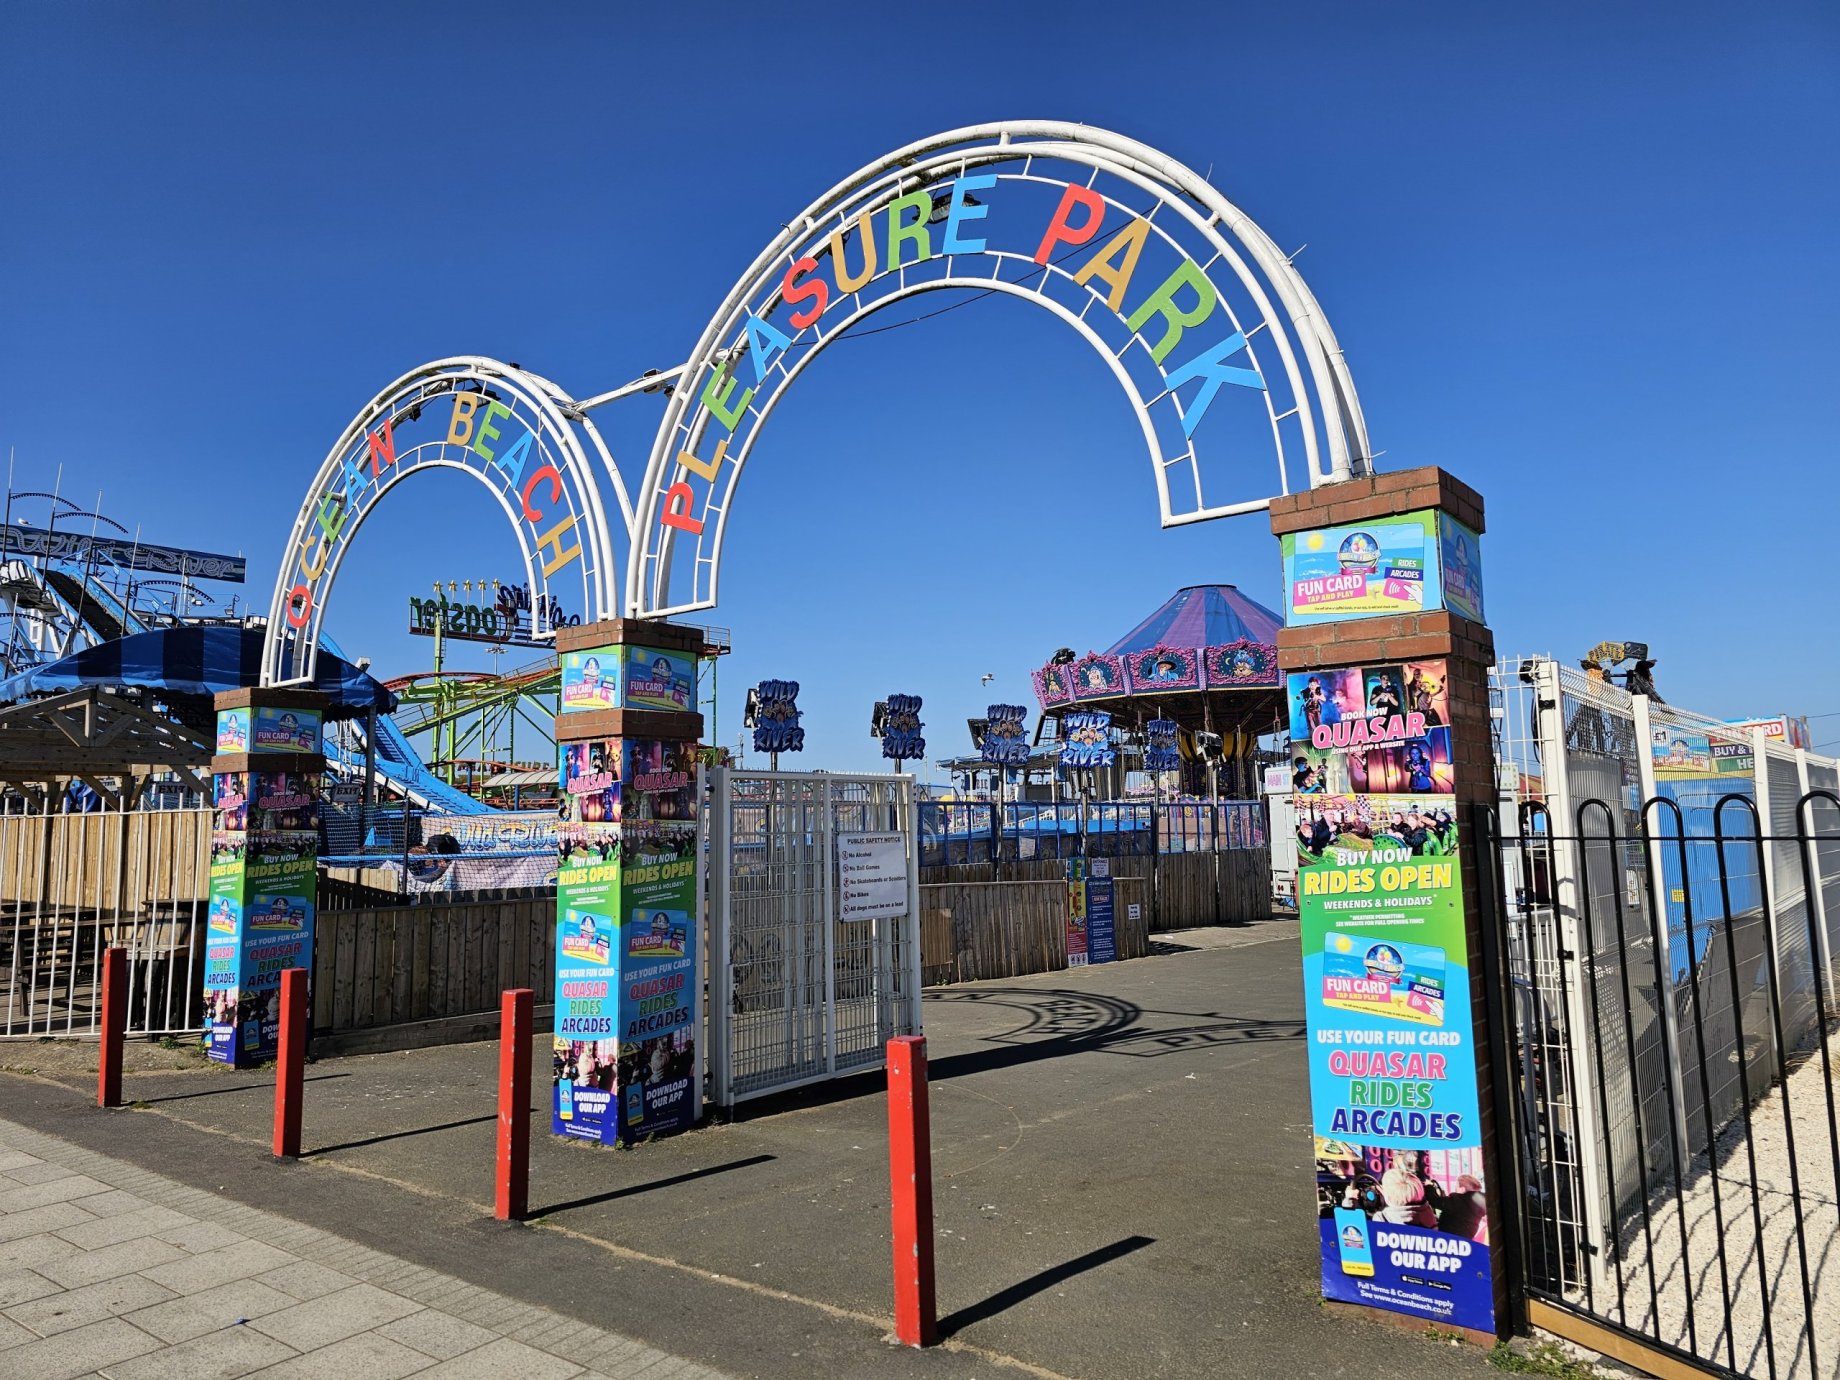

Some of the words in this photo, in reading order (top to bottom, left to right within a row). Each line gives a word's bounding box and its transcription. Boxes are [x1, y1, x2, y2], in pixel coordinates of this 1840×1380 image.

[660, 173, 998, 535] PLEASURE
[1034, 182, 1266, 439] PARK
[286, 418, 396, 629] OCEAN
[447, 392, 581, 579] BEACH
[1397, 559, 1417, 568] RIDES
[1390, 569, 1419, 579] ARCADES
[1297, 580, 1323, 597] FUN
[1326, 575, 1362, 593] CARD
[1307, 594, 1322, 603] TAP
[1322, 592, 1336, 602] AND
[1337, 590, 1354, 600] PLAY
[566, 686, 577, 696] FUN
[578, 684, 592, 694] CARD
[630, 681, 644, 691] FUN
[646, 682, 663, 692] CARD
[759, 680, 799, 700] WILD
[888, 695, 922, 713] WILD
[988, 704, 1027, 721] WILD
[1065, 713, 1111, 728] WILD
[1341, 711, 1364, 720] BOOK
[1366, 706, 1388, 716] NOW
[1312, 712, 1426, 749] QUASAR
[1654, 731, 1667, 740] £1
[753, 729, 804, 752] RIVER
[882, 737, 925, 759] RIVER
[1362, 744, 1374, 752] APP
[1380, 740, 1405, 750] WEBSITE
[981, 744, 1031, 763] RIVER
[1060, 750, 1116, 766] RIVER
[1714, 746, 1736, 756] BUY
[1738, 745, 1746, 755] &
[1738, 758, 1754, 770] HE
[567, 772, 612, 794] QUASAR
[634, 771, 688, 790] QUASAR
[159, 785, 186, 793] EXIT
[259, 794, 310, 809] QUASAR
[500, 821, 559, 849] Rive
[264, 856, 279, 864] BUY
[572, 856, 586, 868] BUY
[587, 854, 603, 865] NOW
[642, 855, 659, 866] BUY
[660, 852, 678, 862] NOW
[1337, 851, 1368, 866] BUY
[1372, 848, 1412, 864] NOW
[246, 864, 281, 878] RIDES
[282, 860, 314, 874] OPEN
[560, 869, 588, 886] RIDES
[592, 865, 617, 882] OPEN
[624, 866, 660, 886] RIDES
[662, 861, 694, 880] OPEN
[1304, 868, 1376, 895] RIDES
[1380, 863, 1452, 891] OPEN
[1324, 899, 1373, 910] WEEKENDS
[1375, 898, 1382, 908] &
[259, 936, 276, 944] YOUR
[278, 934, 290, 942] FUN
[291, 932, 309, 940] CARD
[564, 937, 574, 946] FUN
[575, 938, 589, 947] CARD
[632, 937, 644, 946] FUN
[645, 936, 661, 944] CARD
[209, 946, 234, 958] QUASAR
[250, 942, 302, 960] QUASAR
[213, 960, 230, 971] RIDES
[257, 955, 295, 972] RIDES
[624, 972, 638, 981] USE
[638, 966, 658, 977] YOUR
[658, 962, 671, 972] FUN
[671, 959, 691, 969] CARD
[208, 972, 235, 984] ARCADES
[559, 970, 570, 978] USE
[570, 969, 586, 978] YOUR
[586, 968, 597, 977] FUN
[598, 968, 614, 976] CARD
[1420, 976, 1438, 986] RIDES
[562, 982, 608, 998] QUASAR
[630, 973, 684, 1000] QUASAR
[1327, 979, 1351, 992] FUN
[1354, 980, 1388, 994] CARD
[1414, 984, 1441, 998] ARCADES
[570, 999, 601, 1016] RIDES
[639, 992, 678, 1016] RIDES
[562, 1017, 612, 1033] ARCADES
[627, 1006, 689, 1037] ARCADES
[268, 1032, 278, 1040] OU
[1317, 1030, 1343, 1044] USE
[1344, 1030, 1384, 1044] YOUR
[1387, 1031, 1416, 1045] FUN
[1418, 1032, 1461, 1046] CARD
[1328, 1050, 1447, 1080] QUASAR
[646, 1078, 688, 1100] DOWNLOAD
[1350, 1080, 1433, 1109] RIDES
[574, 1092, 611, 1104] DOWNLOAD
[652, 1096, 668, 1109] OUR
[669, 1091, 683, 1103] APP
[578, 1104, 593, 1112] OUR
[594, 1105, 606, 1114] APP
[1330, 1107, 1462, 1141] ARCADES
[1376, 1232, 1472, 1256] DOWNLOAD
[1390, 1250, 1426, 1270] OUR
[1427, 1255, 1462, 1272] APP
[1358, 1282, 1370, 1290] Full
[1371, 1284, 1390, 1294] Terms
[1390, 1288, 1396, 1296] &
[1398, 1290, 1433, 1304] Conditions
[1434, 1298, 1454, 1309] apply
[1360, 1290, 1373, 1298] See
[1374, 1294, 1453, 1316] www.oceanbeach.co.uk
